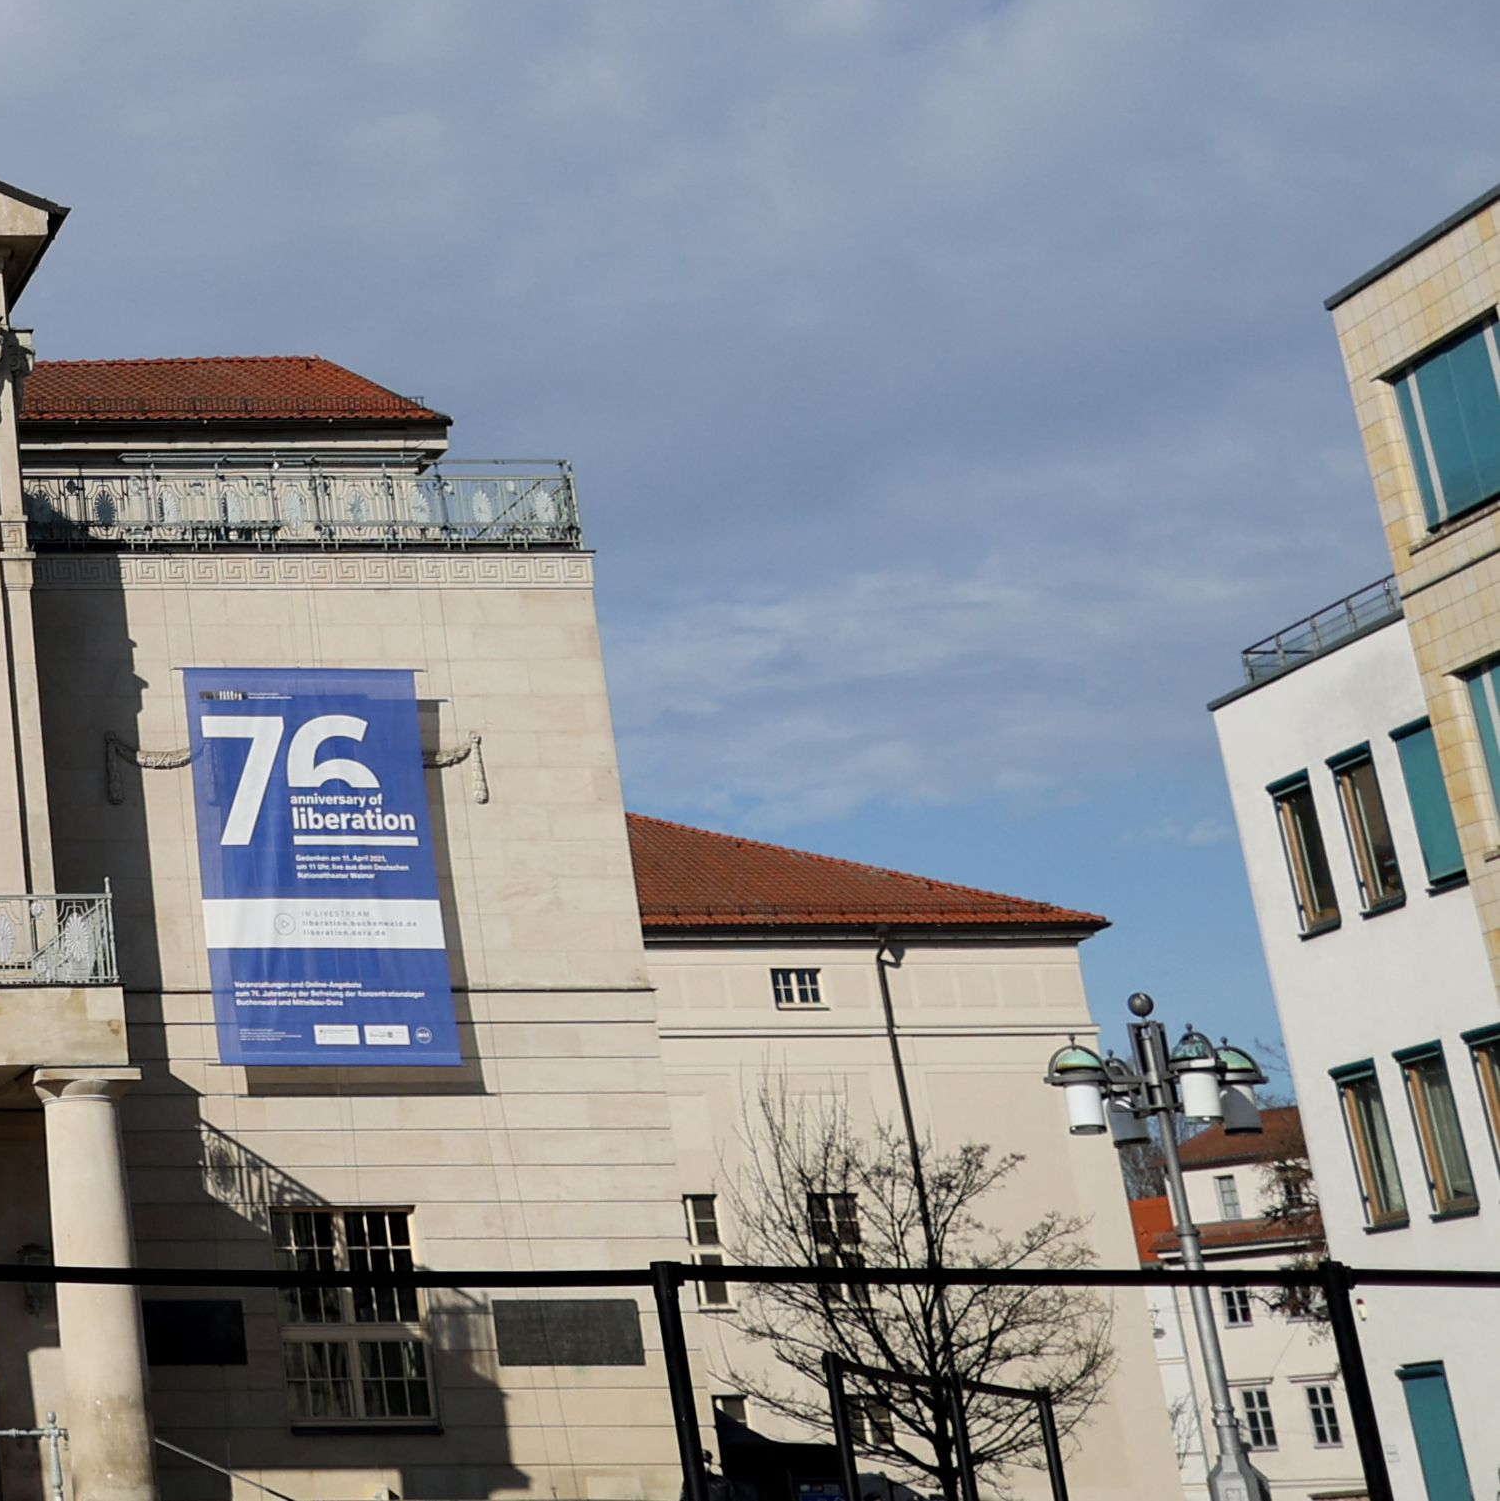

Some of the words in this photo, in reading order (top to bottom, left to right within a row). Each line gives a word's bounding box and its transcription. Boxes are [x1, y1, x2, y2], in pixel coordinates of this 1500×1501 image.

[201, 715, 380, 846] 76
[290, 793, 366, 808] anniversary
[368, 793, 383, 806] of
[292, 807, 416, 831] liberation
[352, 854, 369, 863] April
